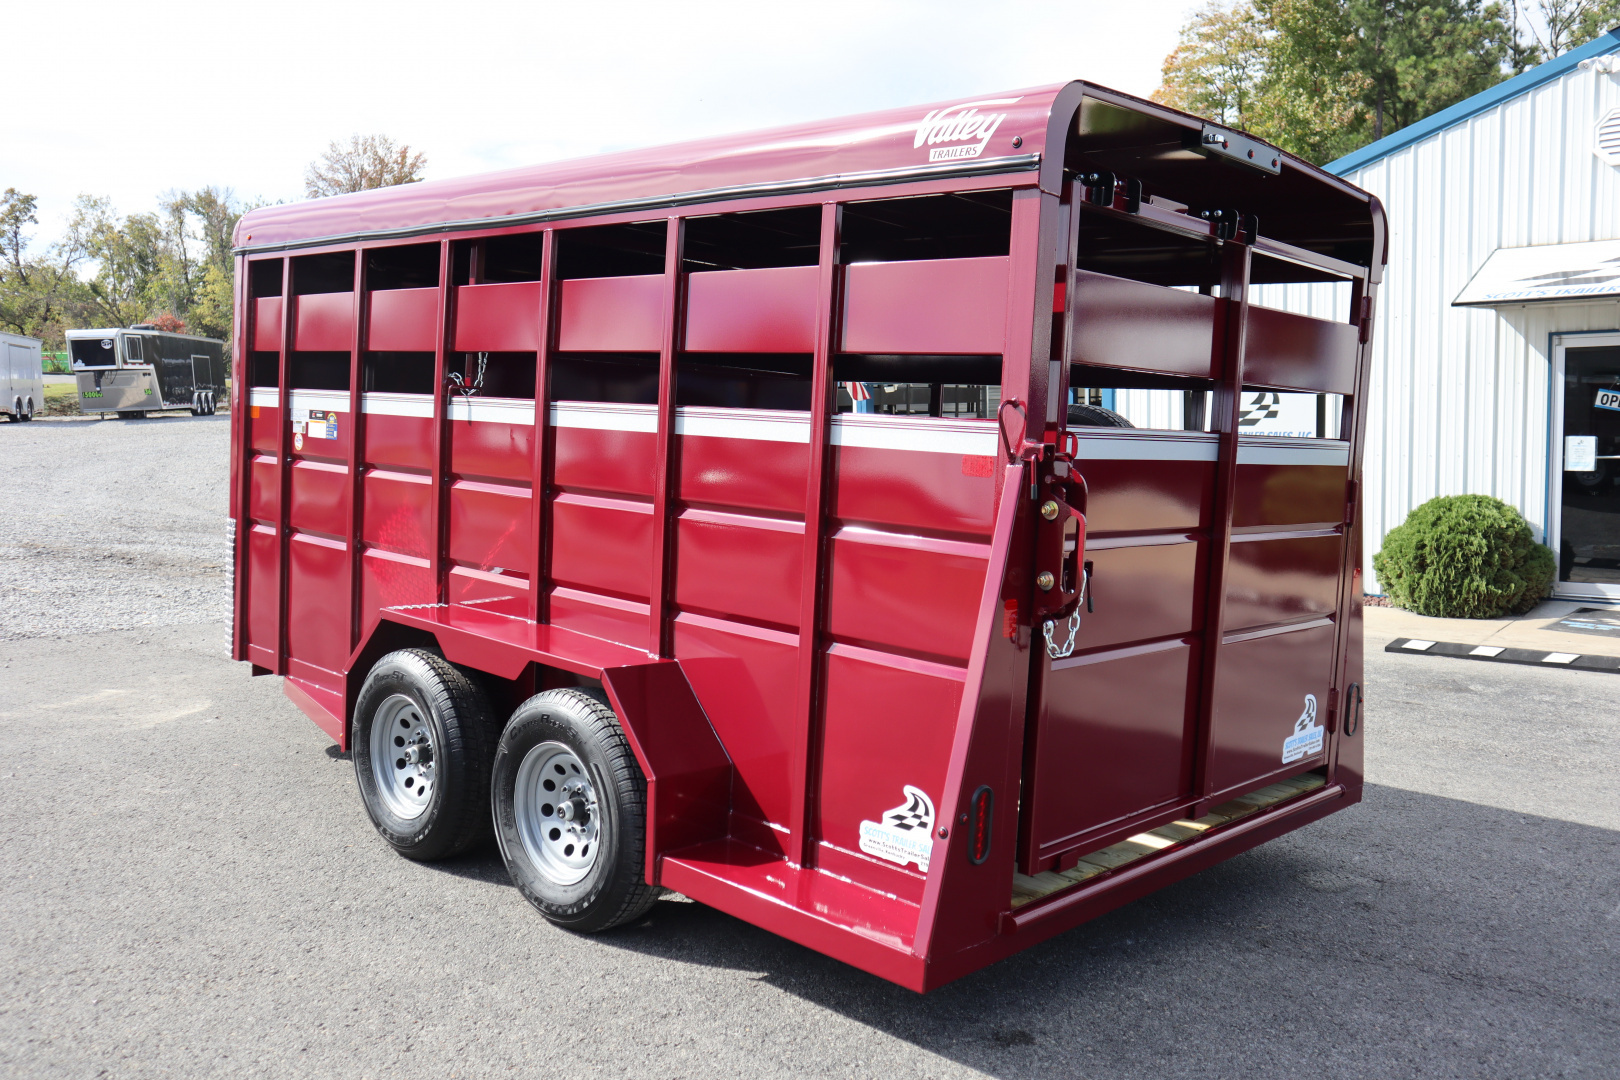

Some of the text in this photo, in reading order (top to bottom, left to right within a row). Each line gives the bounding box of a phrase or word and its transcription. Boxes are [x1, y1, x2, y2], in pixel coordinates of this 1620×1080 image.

[914, 96, 1024, 149] Valley
[932, 146, 977, 159] TRAILERS
[1483, 290, 1549, 300] SCOTT'S
[1601, 393, 1620, 408] OP
[864, 826, 931, 855] SCOTT'S TRAILER SAL
[868, 838, 930, 861] www.ScottsTrailerSal
